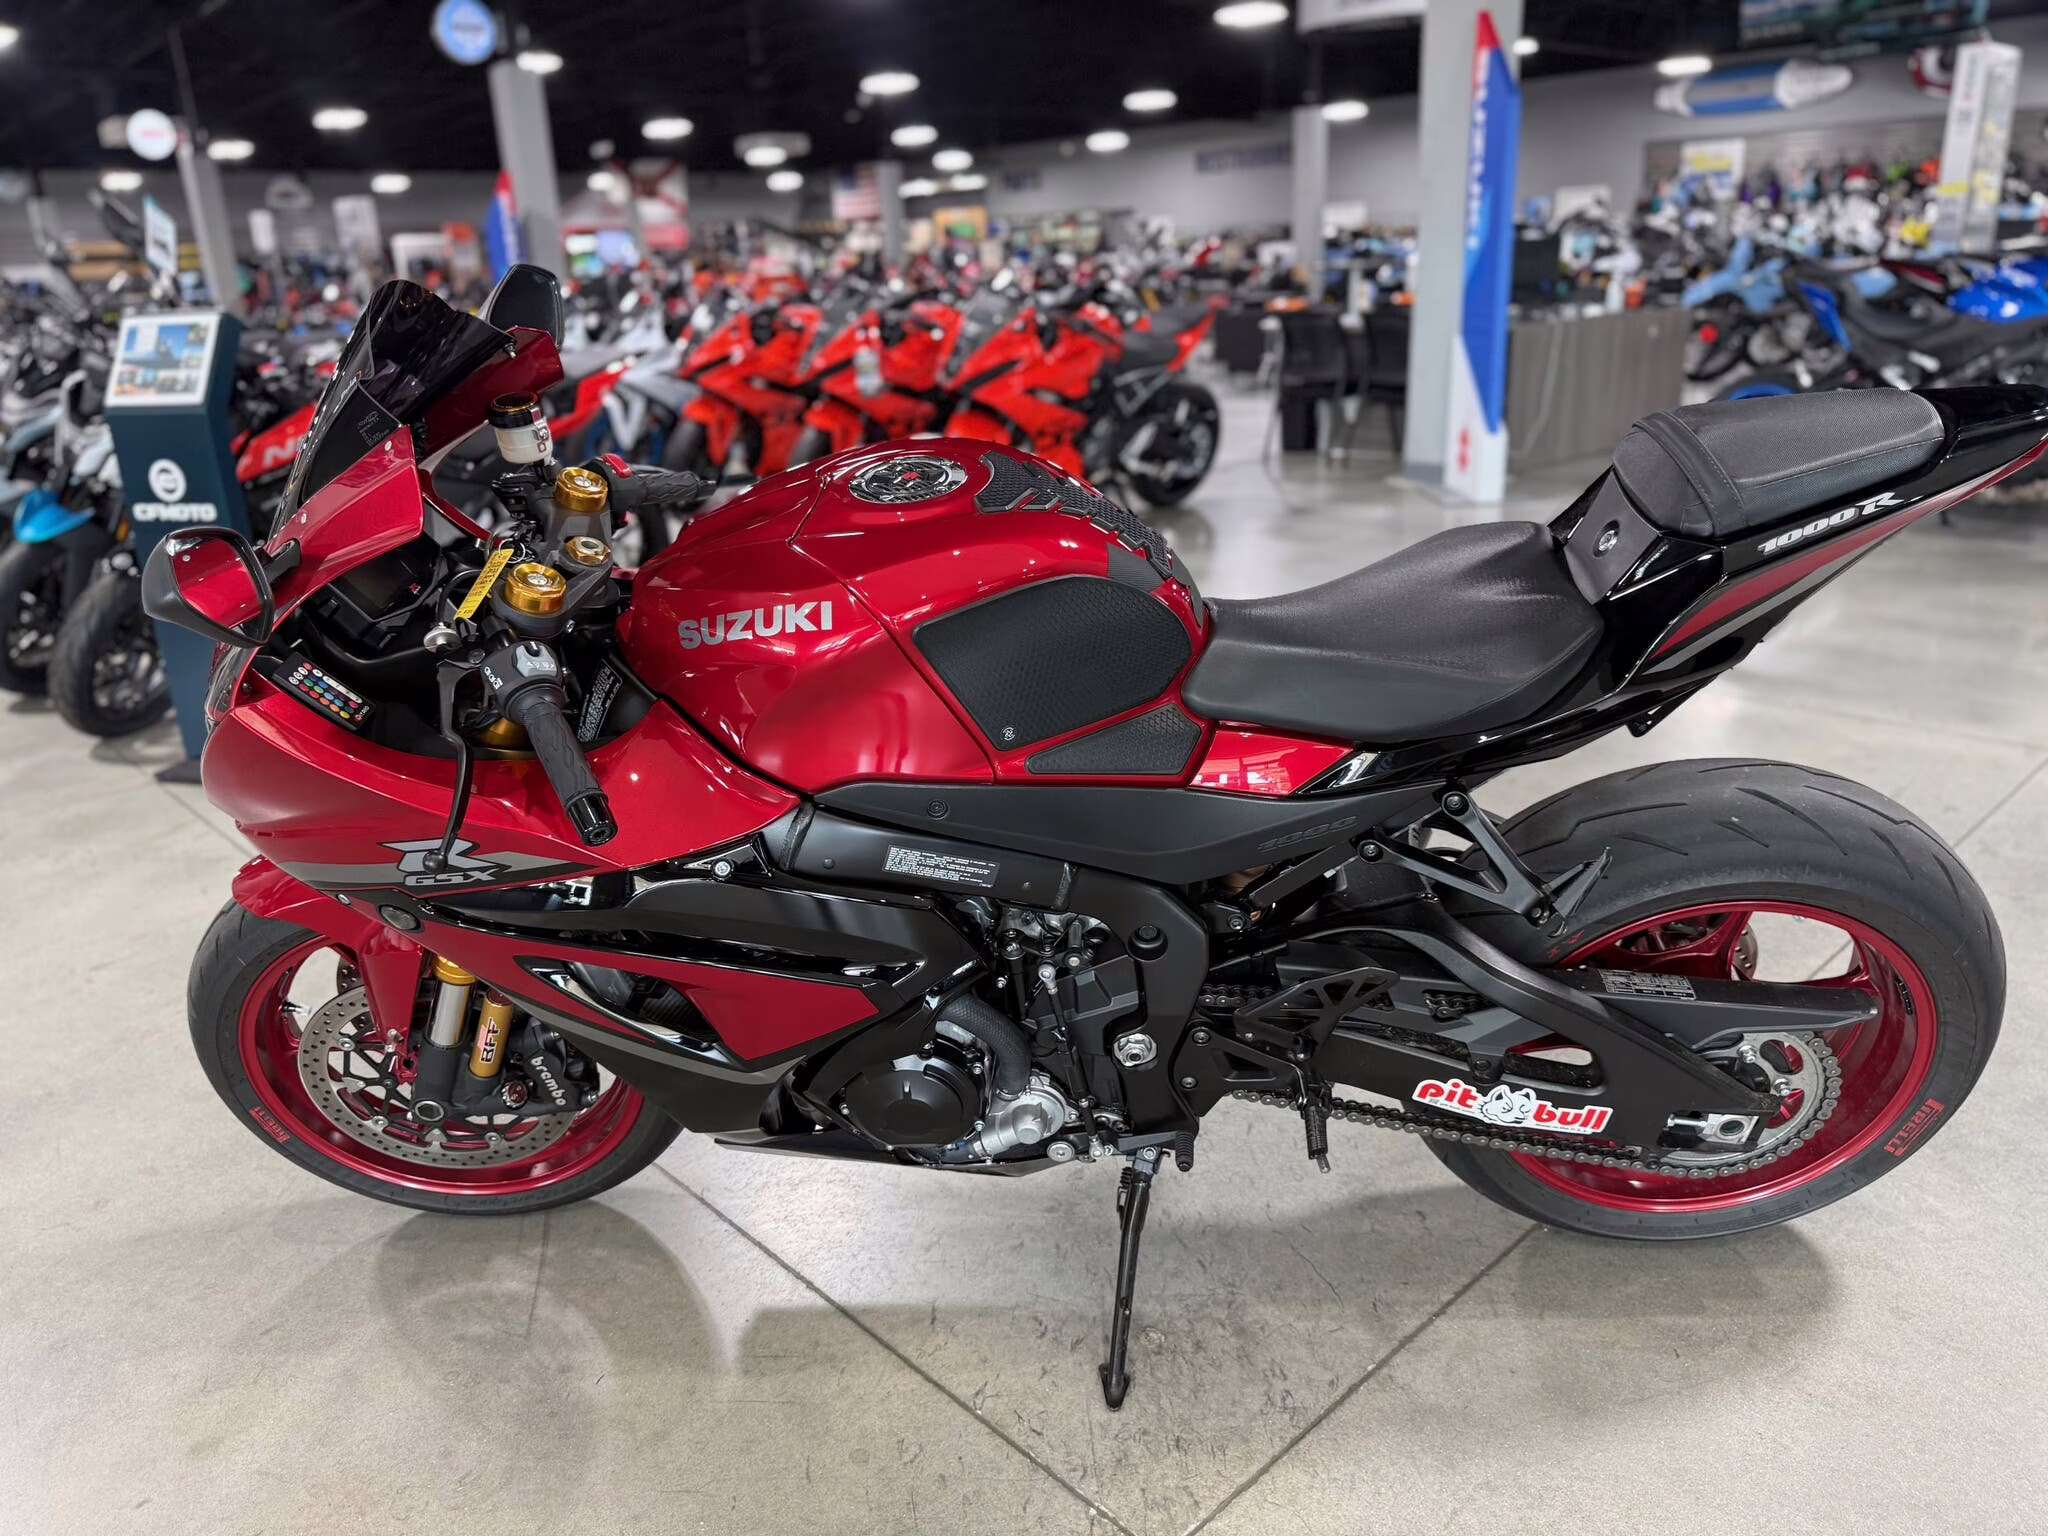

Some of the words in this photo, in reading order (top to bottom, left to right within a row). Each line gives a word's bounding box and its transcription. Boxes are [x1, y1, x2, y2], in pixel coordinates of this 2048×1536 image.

[1757, 507, 1859, 555] 1000
[1855, 491, 1905, 515] R
[678, 600, 833, 649] SUZUKI
[404, 868, 501, 886] GSX
[531, 1056, 567, 1106] brembo
[1417, 1082, 1479, 1109] pit
[1533, 1103, 1610, 1131] bull
[1883, 1098, 1945, 1158] PIRELLI
